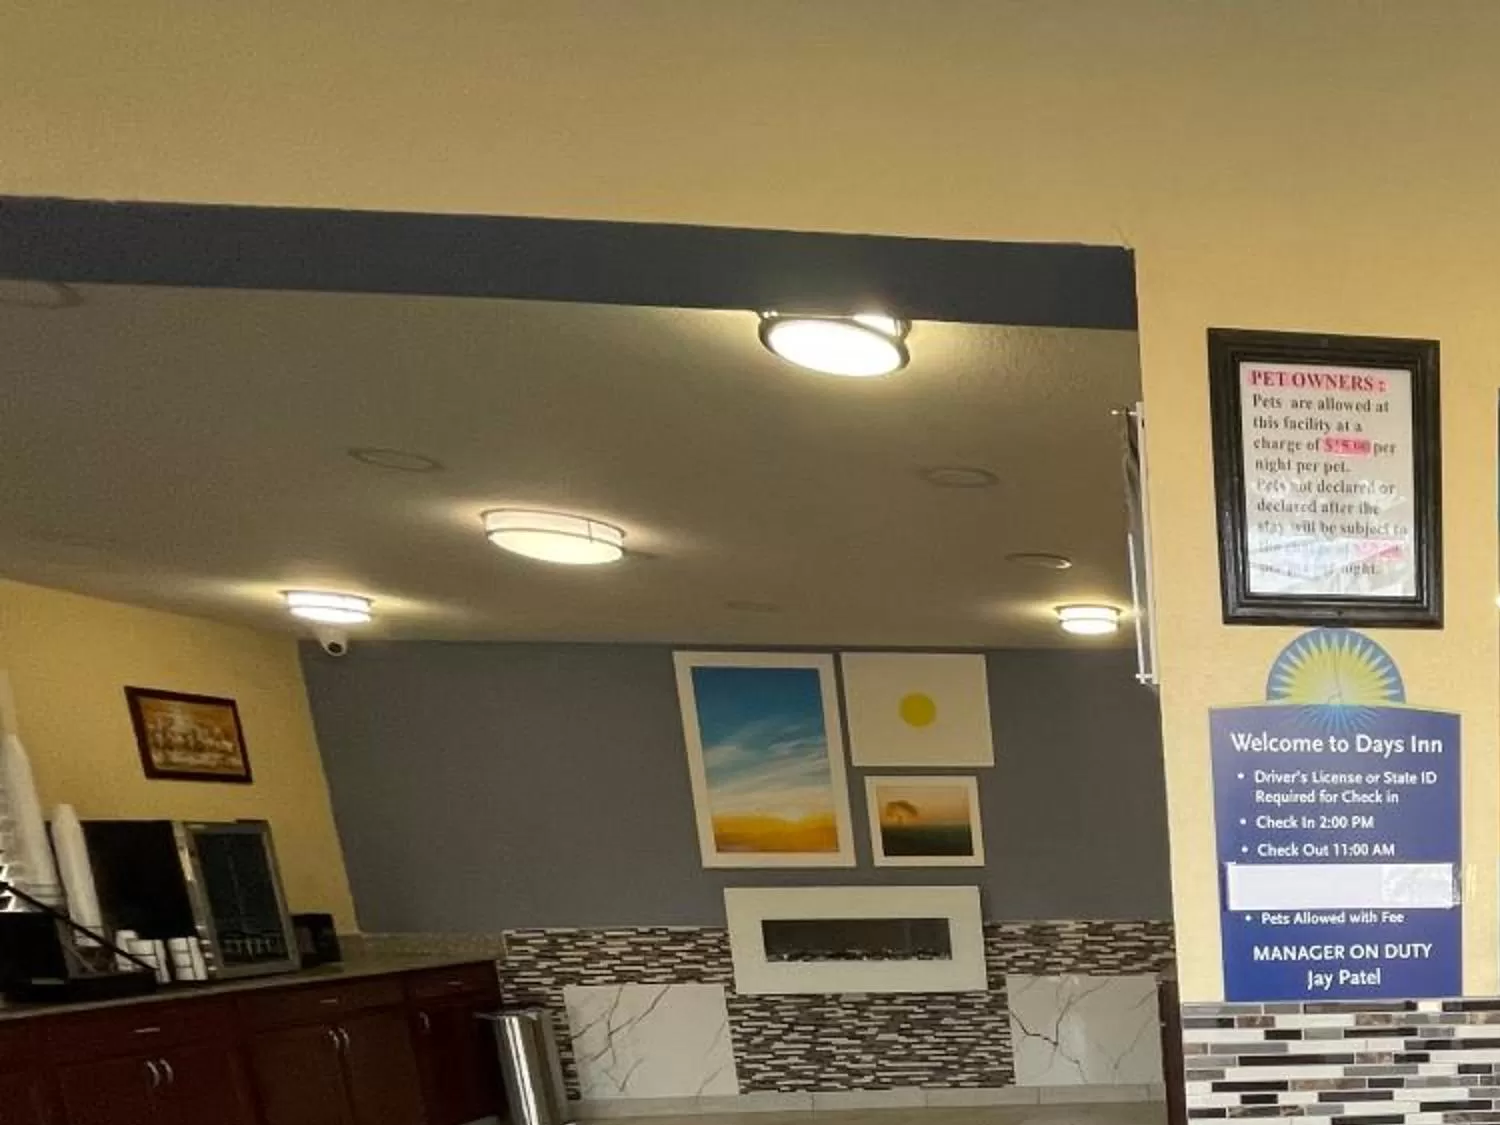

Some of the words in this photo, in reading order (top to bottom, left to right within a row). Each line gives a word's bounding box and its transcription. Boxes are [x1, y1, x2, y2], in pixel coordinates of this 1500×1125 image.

[1251, 369, 1287, 387] PET
[1292, 373, 1374, 391] OWNERS
[1252, 393, 1282, 408] Pets
[1291, 397, 1313, 410] are
[1317, 396, 1371, 412] allowed
[1375, 399, 1390, 413] at
[1253, 415, 1279, 430] this
[1283, 416, 1331, 434] facility
[1336, 421, 1350, 432] at
[1354, 424, 1363, 432] a
[1253, 436, 1302, 453] charge
[1306, 437, 1320, 452] of
[1373, 441, 1396, 457] per
[1255, 457, 1292, 474] night
[1296, 462, 1319, 475] per
[1317, 480, 1376, 495] declared
[1379, 483, 1396, 495] or
[1257, 499, 1317, 514] declared
[1321, 501, 1356, 514] after
[1360, 501, 1380, 516] the
[1320, 520, 1336, 534] be
[1340, 521, 1389, 538] subject
[1230, 732, 1323, 752] Welcome
[1330, 735, 1349, 752] to
[1355, 734, 1404, 758] Days
[1410, 735, 1443, 754] Inn
[1254, 769, 1308, 784] Driver's
[1312, 771, 1362, 785] License
[1365, 773, 1381, 784] or
[1383, 771, 1417, 785] State
[1421, 771, 1438, 785] ID
[1255, 789, 1315, 807] Required
[1319, 789, 1339, 803] for
[1341, 789, 1383, 804] Check
[1386, 789, 1399, 804] in
[1256, 815, 1298, 830] Check
[1301, 815, 1315, 830] In
[1319, 815, 1349, 830] 2:00
[1351, 816, 1375, 830] PM
[1257, 843, 1299, 858] Check
[1303, 843, 1330, 858] Out
[1333, 844, 1370, 858] 11:00
[1372, 844, 1396, 858] AM
[1261, 911, 1291, 926] Pets
[1293, 911, 1346, 925] Allowed
[1349, 911, 1378, 925] with
[1381, 911, 1405, 924] Fee
[1253, 945, 1345, 961] MANAGER
[1349, 944, 1380, 960] ON
[1384, 943, 1433, 960] DUTY
[1307, 969, 1334, 990] Jay
[1339, 968, 1382, 986] Patel
